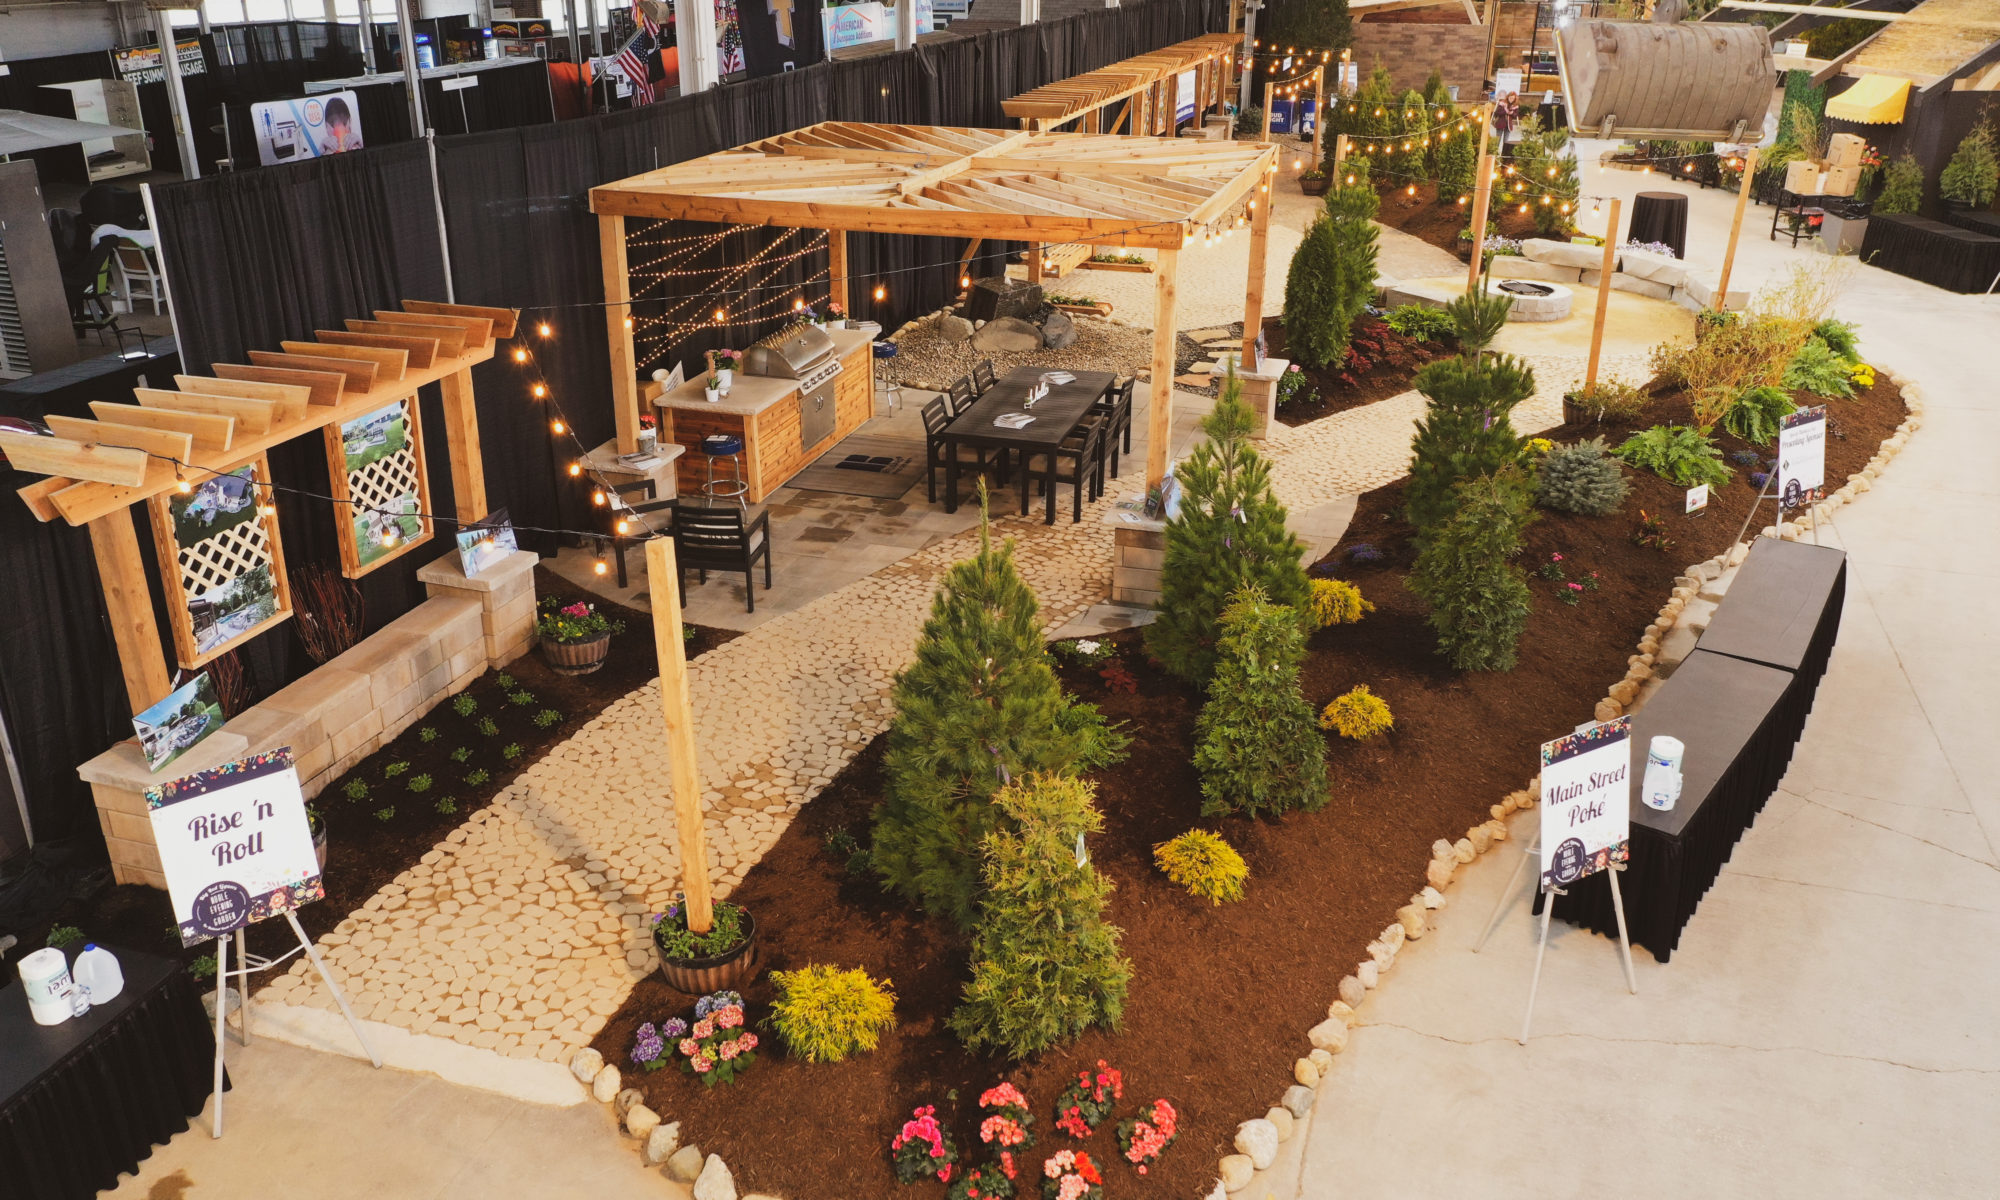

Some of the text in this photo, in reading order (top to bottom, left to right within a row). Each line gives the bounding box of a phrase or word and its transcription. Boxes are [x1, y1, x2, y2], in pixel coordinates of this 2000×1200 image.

[834, 14, 864, 39] AMERICAN
[123, 60, 205, 85] BEEF SUMM AUSAGE
[1546, 763, 1627, 808] Main Street
[187, 799, 275, 842] Rise 'n
[1567, 793, 1607, 827] Poké
[211, 831, 265, 868] Roll
[209, 899, 234, 915] EVENING
[213, 911, 236, 927] GARDEN
